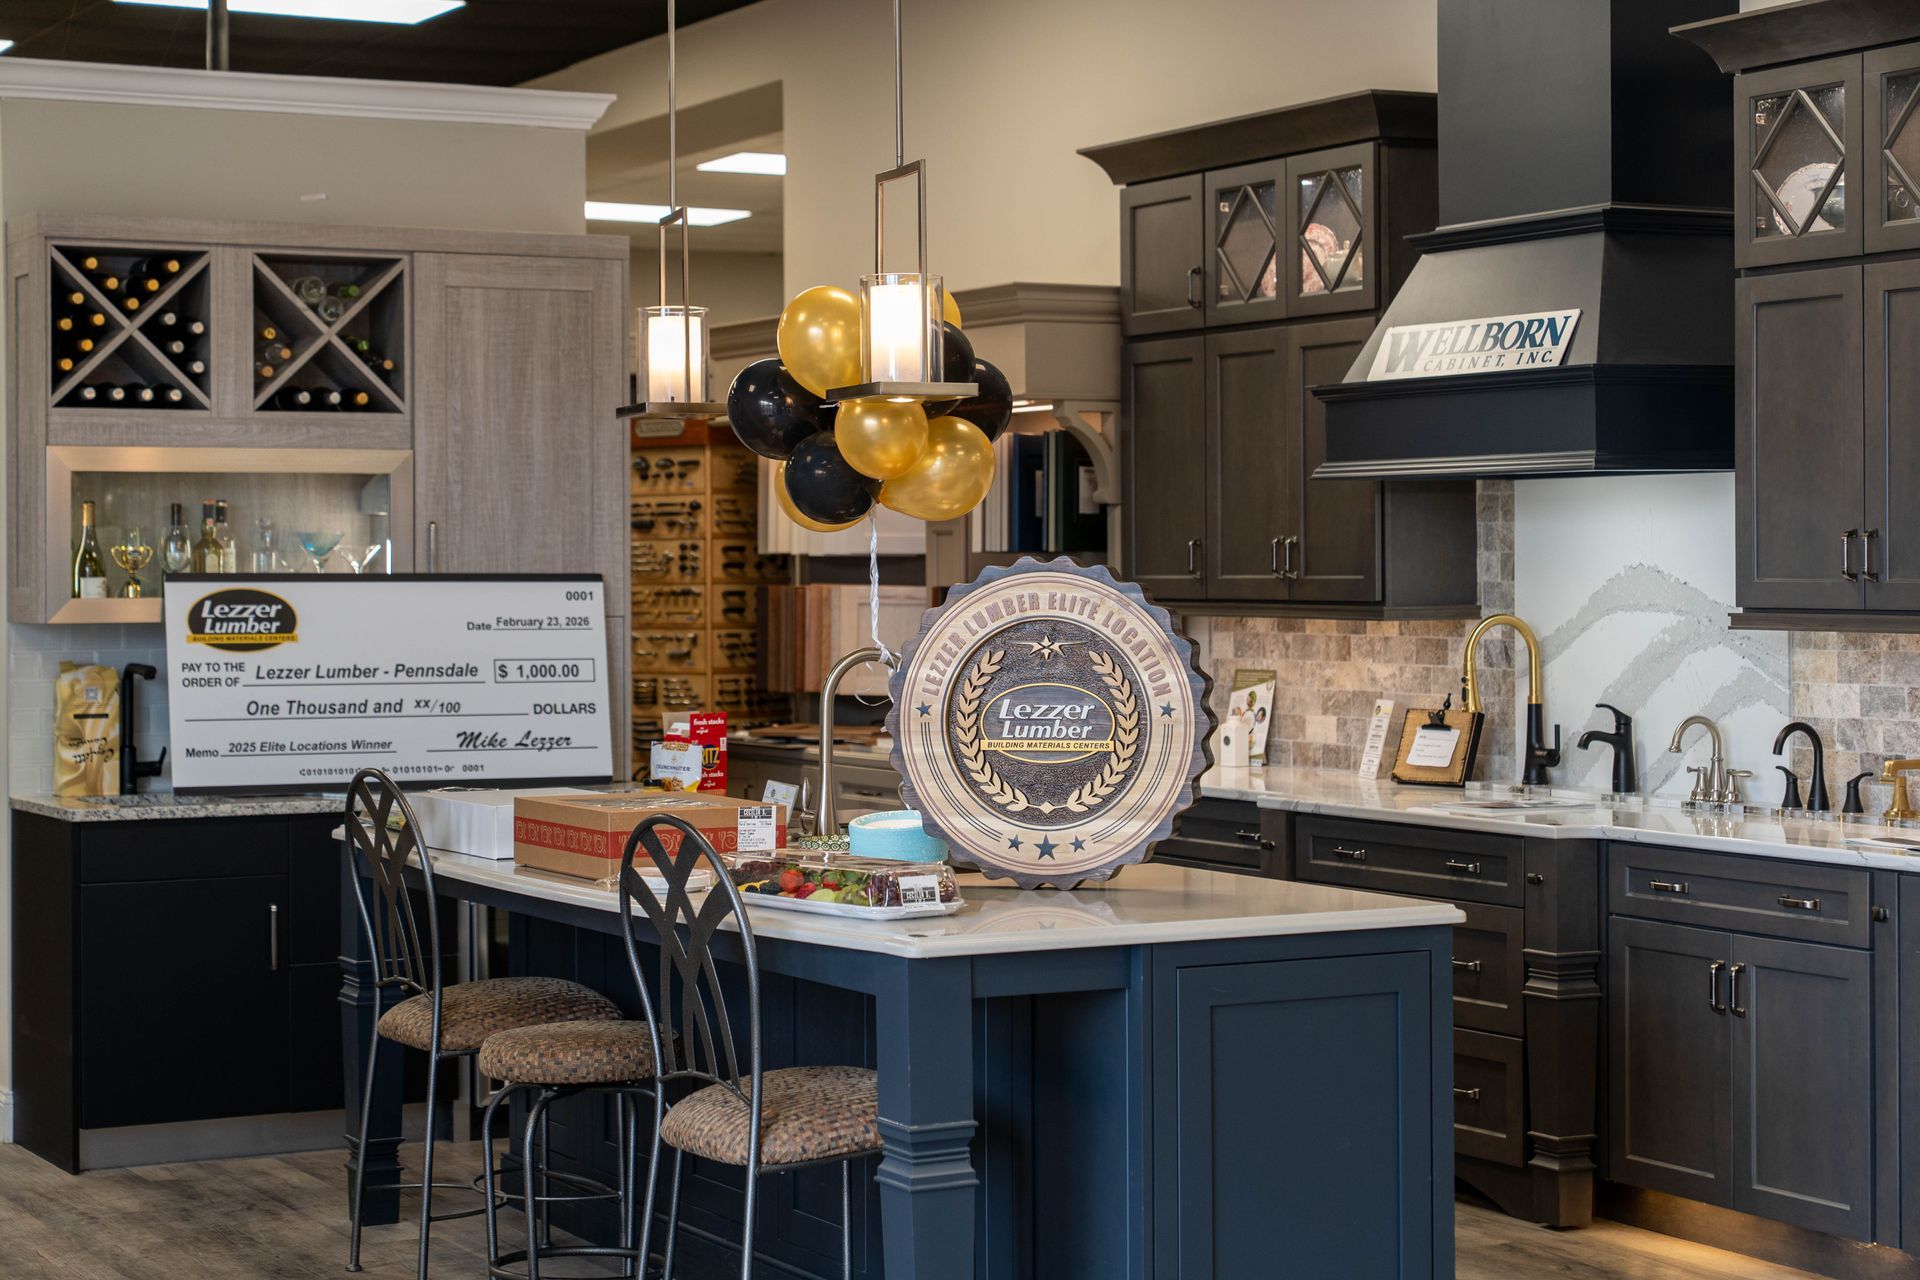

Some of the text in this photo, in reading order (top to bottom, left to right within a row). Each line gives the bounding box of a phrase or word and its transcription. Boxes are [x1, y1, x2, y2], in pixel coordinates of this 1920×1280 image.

[1385, 316, 1572, 373] WELLBORN
[1424, 350, 1552, 372] CABINET, INC.
[566, 591, 594, 601] 0001
[201, 601, 282, 618] Lezzer
[204, 618, 280, 634] Lumber
[467, 617, 589, 631] Date February 23, 2026
[922, 591, 1172, 698] LEZZER LUMBER ELITE LOCATION
[182, 662, 246, 672] PAY TO THE
[182, 678, 222, 688] ORDER
[226, 677, 240, 687] OF
[256, 665, 310, 680] Lezzer
[315, 664, 379, 679] Lumber
[394, 663, 478, 678] Pennsdale
[498, 664, 579, 680] $ 1,000.00
[247, 700, 280, 716] One
[286, 699, 368, 715] Thousand
[373, 699, 403, 713] and
[533, 703, 596, 715] DOLLARS
[998, 699, 1095, 720] Lezzer
[1002, 720, 1092, 739] Lumber
[186, 740, 393, 758] Memo 2025 Elite Locations Winner
[456, 730, 572, 752] Mike Lezzer
[462, 764, 485, 772] 0001
